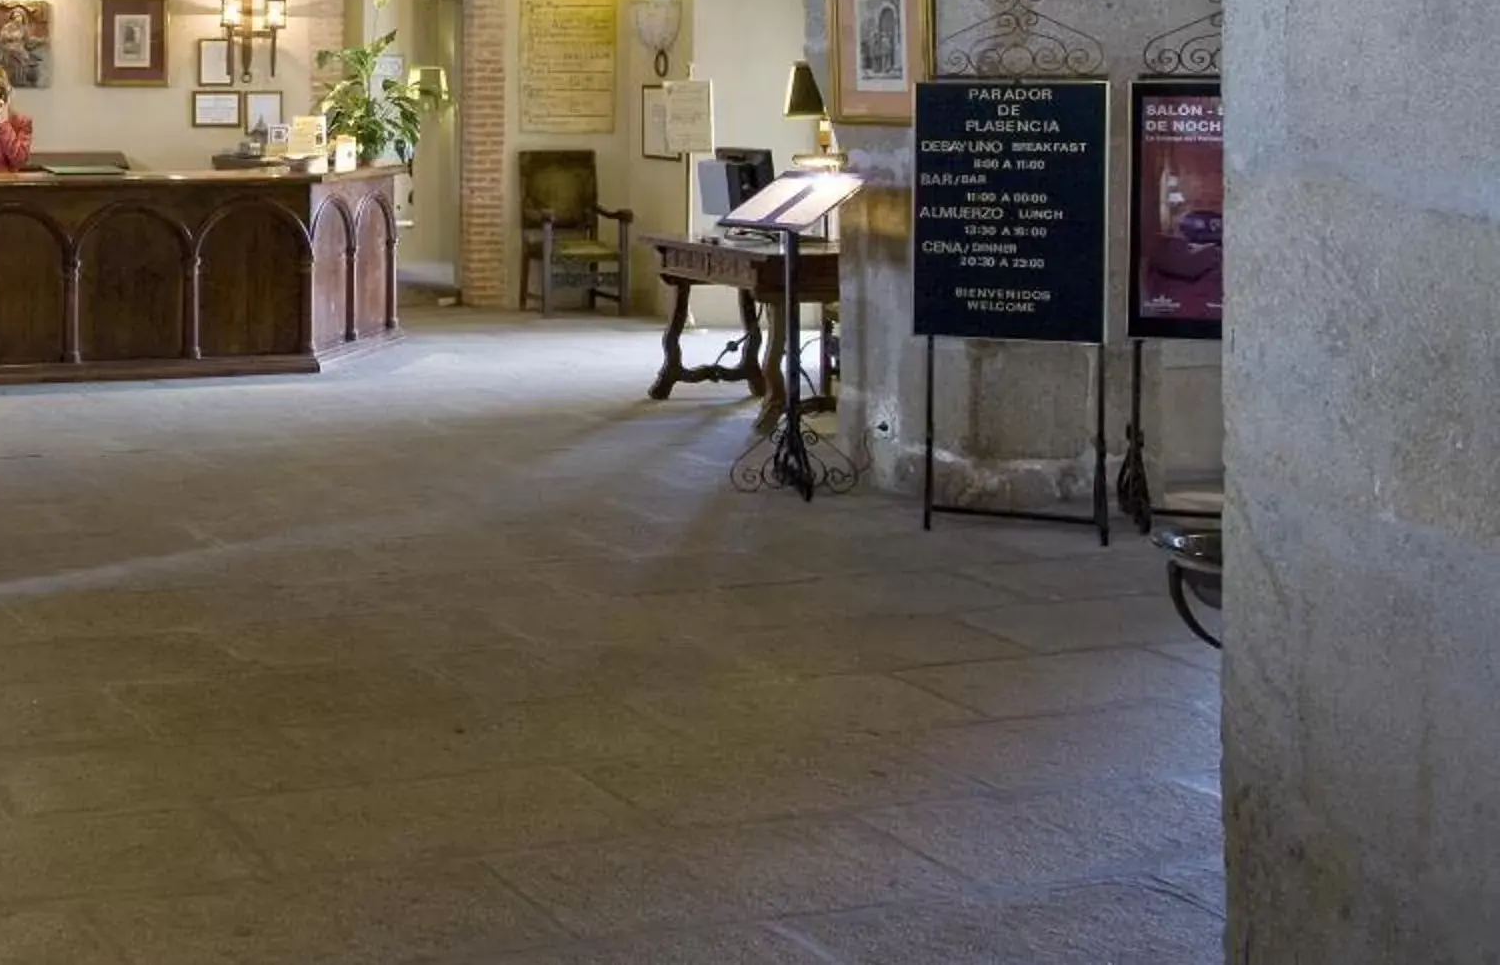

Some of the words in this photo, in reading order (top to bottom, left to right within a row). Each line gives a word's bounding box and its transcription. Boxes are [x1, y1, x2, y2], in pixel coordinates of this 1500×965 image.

[968, 88, 1053, 101] PARADOR
[997, 104, 1021, 117] DE
[965, 120, 1060, 132] PLASENCIA
[1145, 120, 1168, 132] DE
[1172, 120, 1222, 132] NOCH
[921, 140, 1003, 153] DESAYUNO
[1002, 159, 1012, 170] A
[1000, 192, 1012, 202] A
[919, 206, 1004, 220] ALMUERZO
[1018, 209, 1063, 220] LUNCH
[1001, 225, 1011, 236] A
[1000, 257, 1010, 268] A
[955, 287, 1051, 300] BIENVENIDOS
[967, 300, 1037, 313] WELCOME
